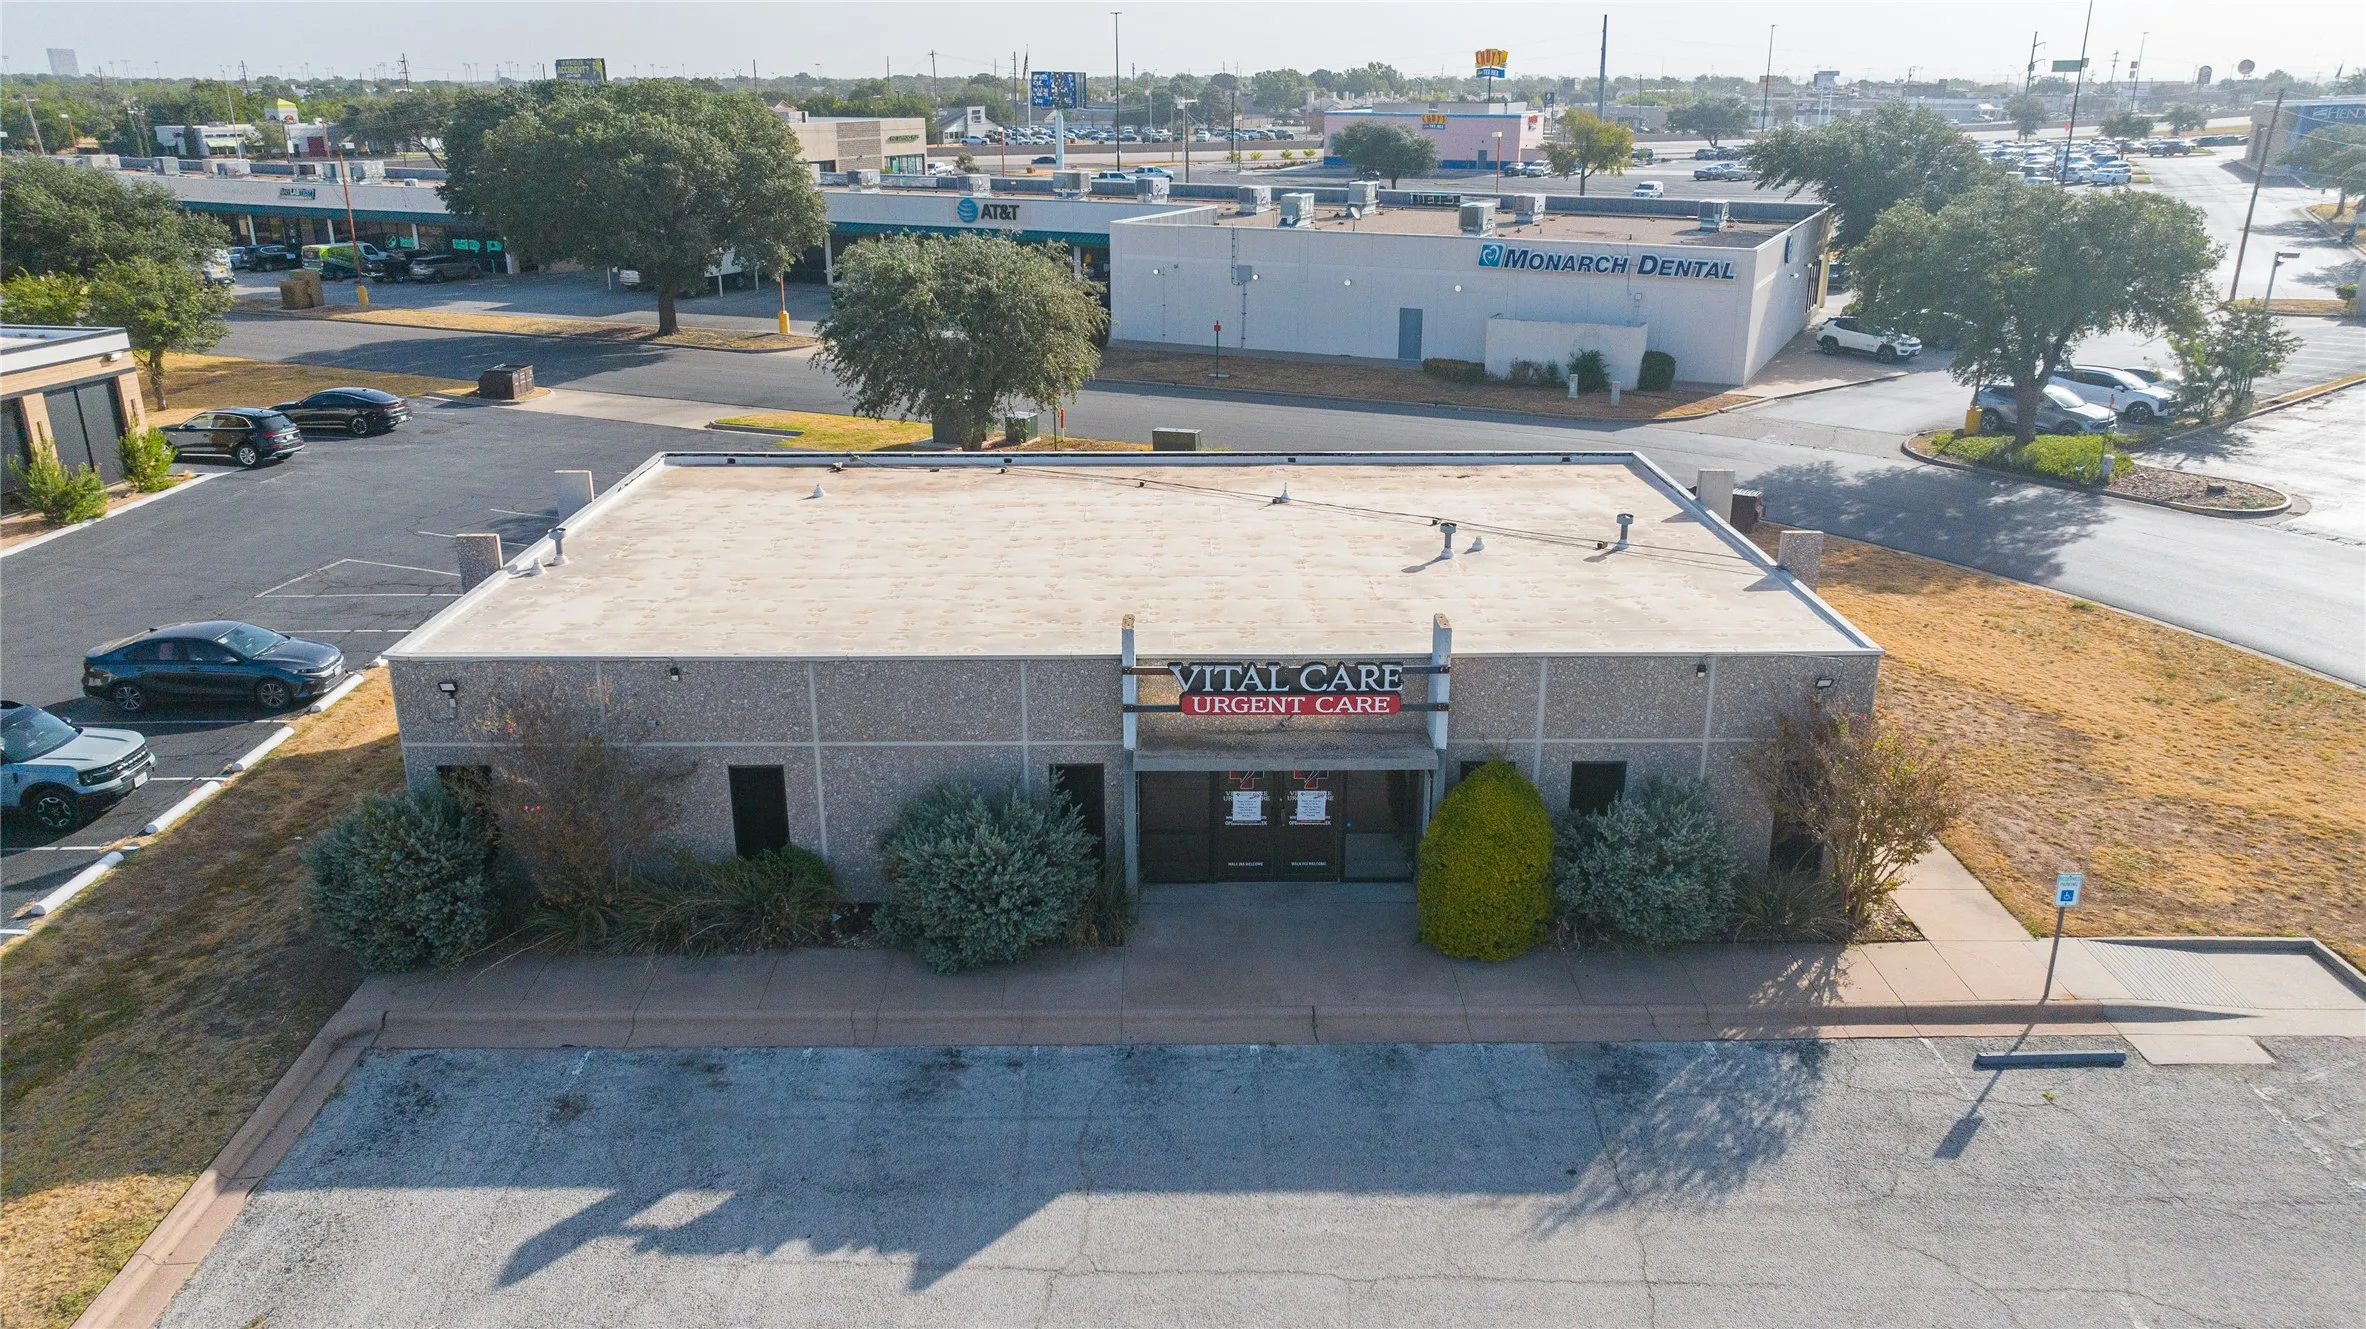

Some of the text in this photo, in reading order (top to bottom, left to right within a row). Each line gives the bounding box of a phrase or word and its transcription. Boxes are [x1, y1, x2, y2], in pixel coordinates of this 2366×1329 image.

[557, 65, 590, 74] ACCIDENT?
[981, 204, 1020, 220] AT&T
[1503, 247, 1736, 280] MONARCH DENTAL
[1168, 664, 1404, 692] VITAL CARE
[1192, 696, 1391, 713] URGENT CARE
